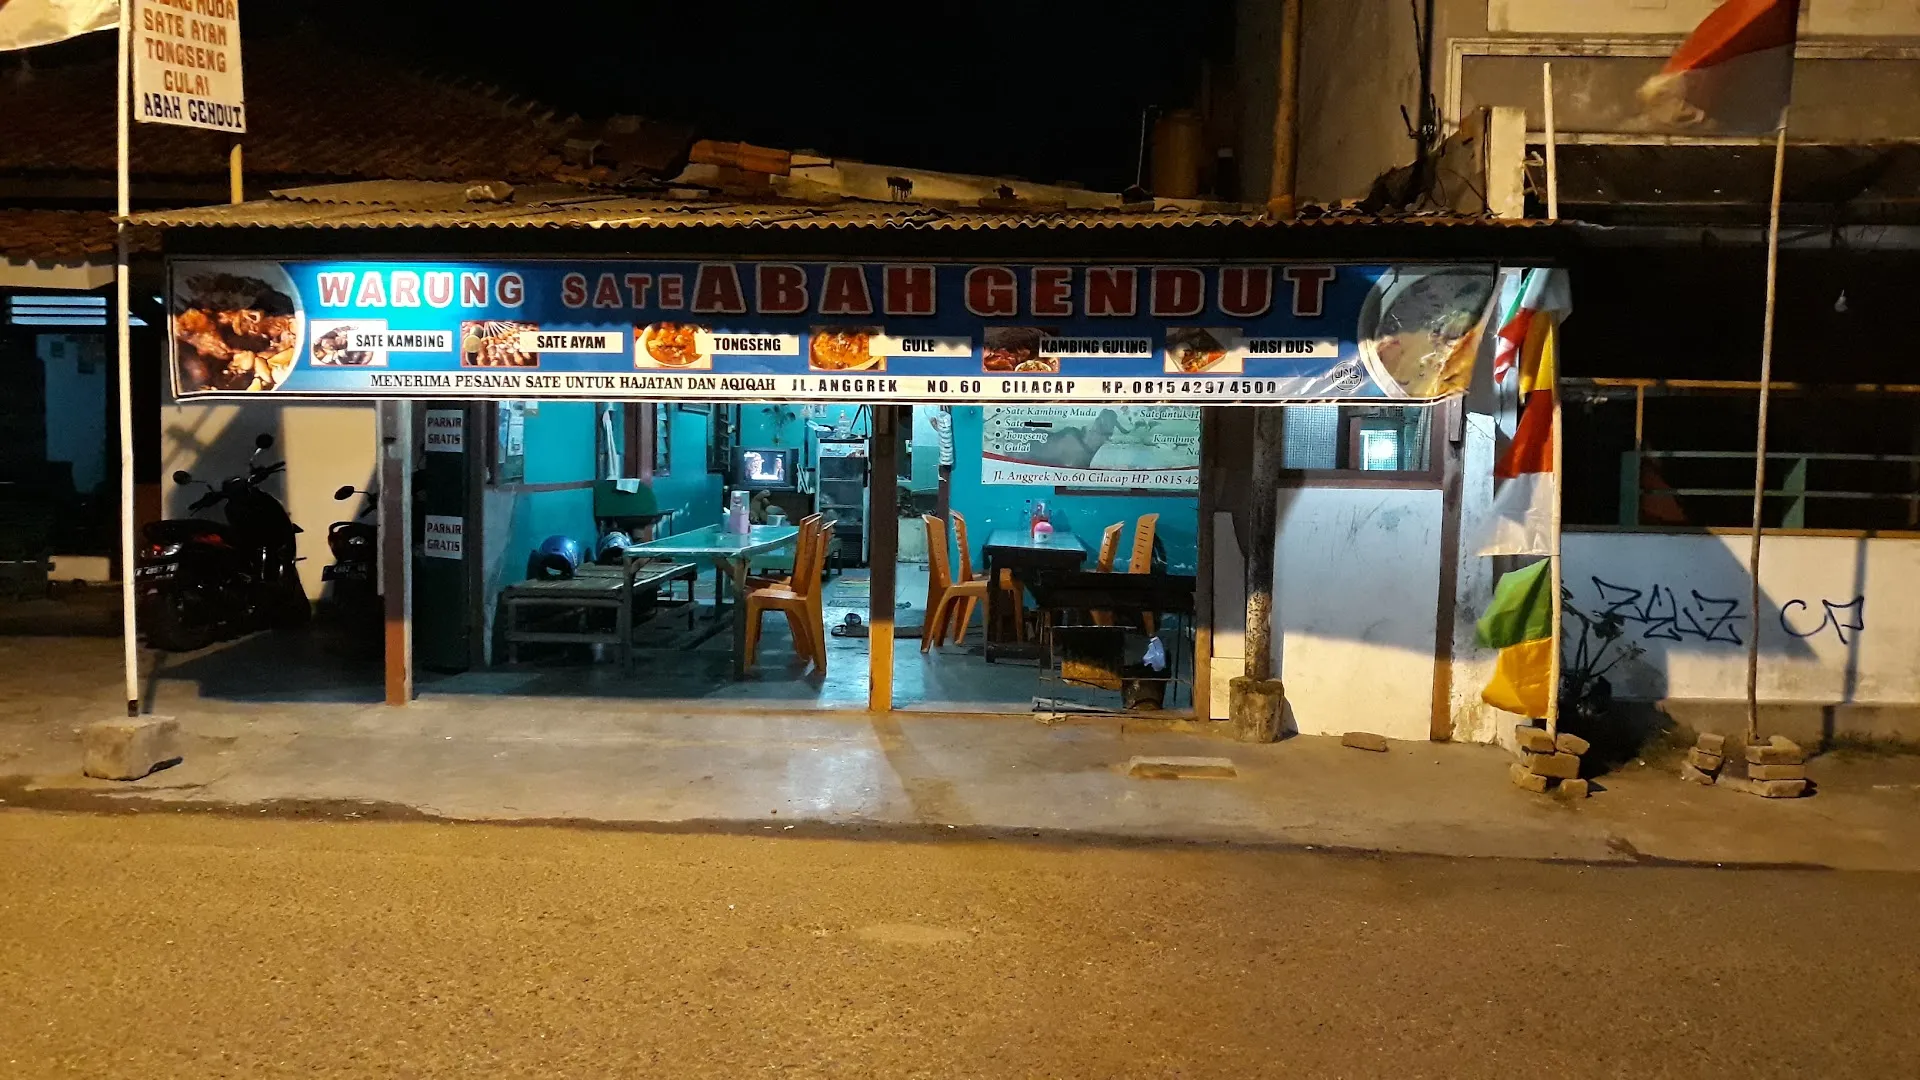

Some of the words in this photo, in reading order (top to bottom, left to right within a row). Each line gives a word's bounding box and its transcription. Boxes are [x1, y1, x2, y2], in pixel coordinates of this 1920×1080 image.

[143, 8, 185, 38] SATE
[191, 19, 227, 46] AYAM
[145, 37, 227, 73] TONGSENG
[164, 70, 211, 96] GULAI
[144, 92, 182, 119] ABAH
[188, 99, 242, 128] GENDUT
[317, 271, 525, 309] WARUNG
[561, 271, 684, 309] SATE
[690, 262, 937, 315] ABAH
[964, 264, 1336, 317] GENDUT
[355, 334, 384, 348] SATE
[387, 334, 445, 348] KAMBING
[536, 335, 568, 349] SATE
[570, 335, 606, 349] AYAM
[714, 337, 781, 351] TONGSENG
[902, 338, 935, 352] GULE
[1041, 340, 1100, 354] KAMBING
[1102, 340, 1147, 354] GULING
[1249, 339, 1282, 354] NASI
[1285, 339, 1314, 354] DUS
[370, 374, 451, 388] MENERIMA
[455, 374, 521, 388] PESANAN
[525, 375, 561, 389] SATE
[565, 375, 616, 389] UNTUK
[620, 376, 684, 390] HAJATAN
[687, 377, 716, 391] DAN
[720, 377, 776, 392] AQIQAH
[1002, 380, 1076, 394] CILACAP
[1005, 407, 1024, 415] Sate
[1027, 407, 1068, 418] Kambing
[1070, 408, 1097, 417] Muda
[427, 416, 462, 429] PARKIR
[1004, 418, 1025, 427] Sate
[427, 433, 461, 446] GRATIS
[1005, 430, 1048, 443] Tongseng
[1004, 443, 1030, 452] Gulai
[993, 470, 1004, 482] Jl.
[1007, 471, 1050, 484] Anggrek
[1053, 471, 1085, 483] No.60
[1088, 472, 1129, 486] Cilacap
[1132, 473, 1152, 484] HP.
[1155, 474, 1182, 485] 0815
[426, 522, 462, 535] PARKIR
[427, 539, 460, 552] GRATIS
